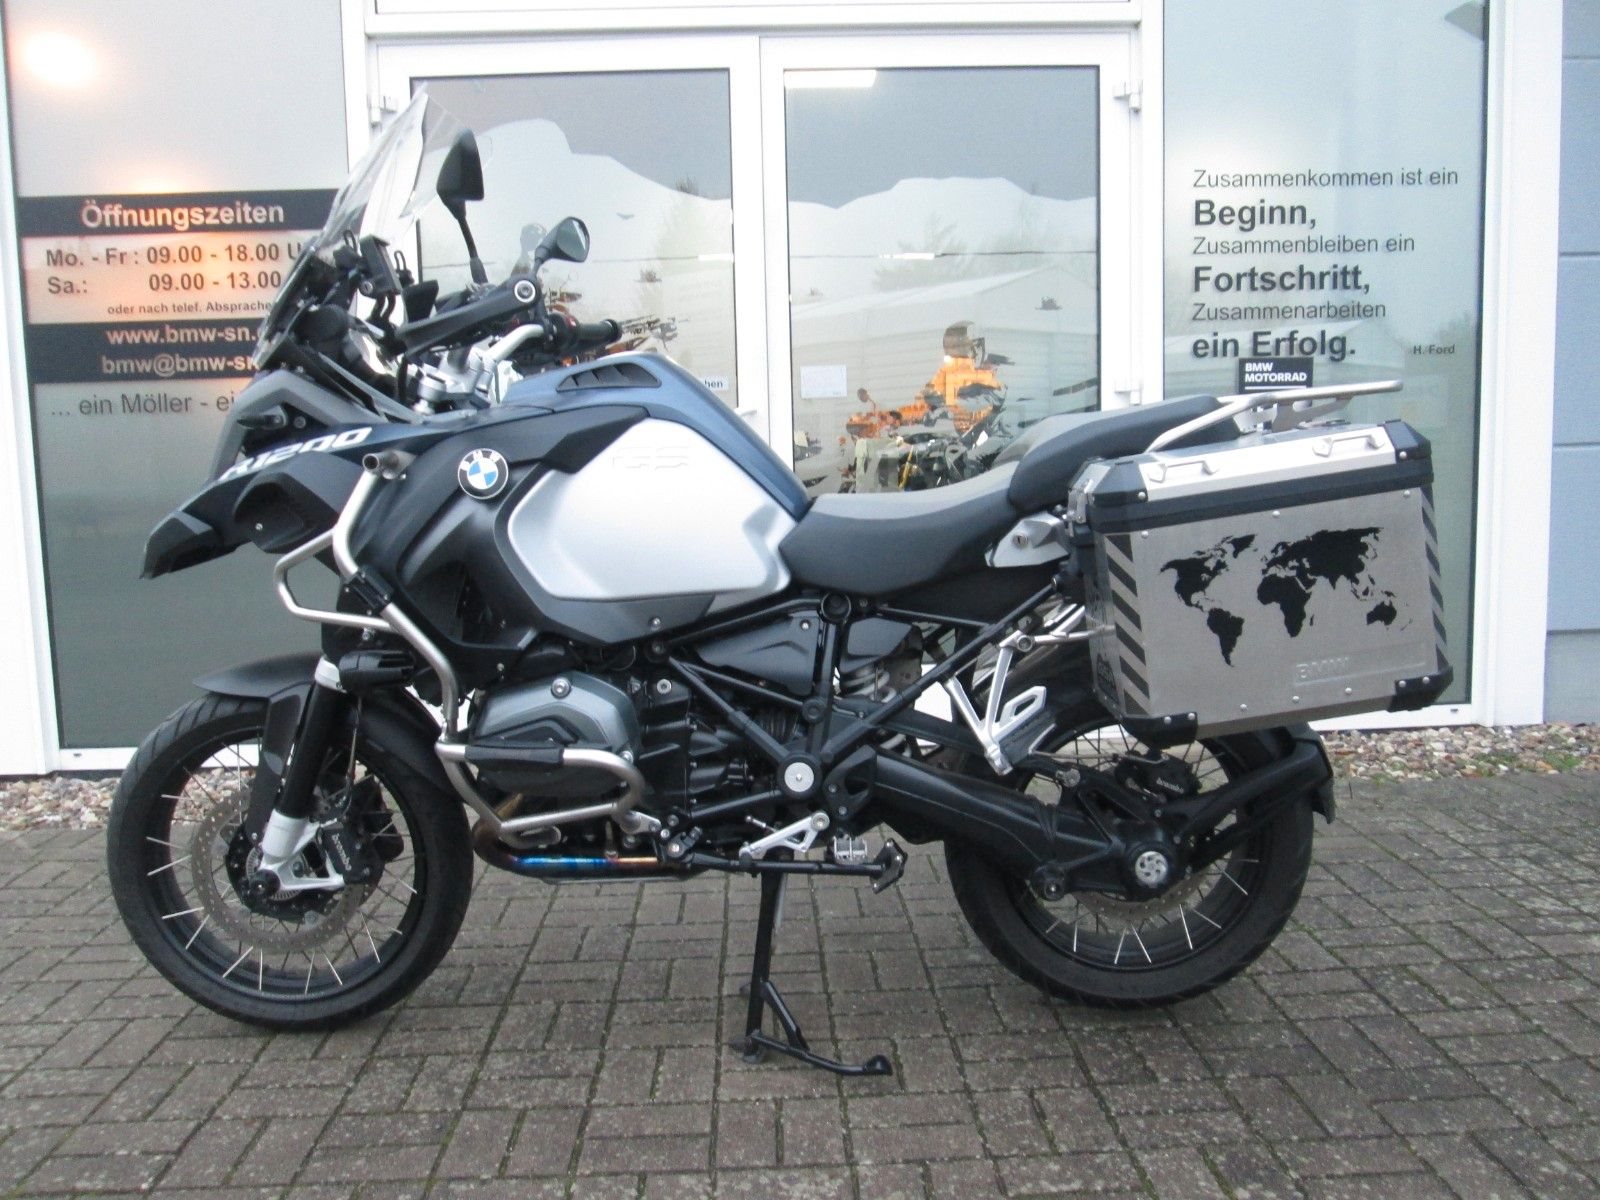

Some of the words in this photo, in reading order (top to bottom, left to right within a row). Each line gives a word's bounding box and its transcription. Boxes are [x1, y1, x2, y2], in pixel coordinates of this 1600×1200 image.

[1192, 168, 1393, 188] Zusammenkommen
[1400, 168, 1423, 186] ist
[1429, 167, 1459, 186] ein
[81, 199, 285, 232] Öffnungszeiten
[1194, 199, 1316, 232] Beginn,
[46, 249, 84, 267] Mo.
[146, 245, 202, 264] 09.00
[224, 243, 280, 262] 18.00
[1192, 235, 1379, 256] Zusammenbleiben
[1385, 234, 1415, 252] ein
[47, 277, 88, 294] Sa.:
[149, 273, 205, 291] 09.00
[226, 271, 282, 290] 13.00
[1194, 264, 1370, 294] Fortschritt,
[107, 305, 135, 315] oder
[138, 303, 168, 314] nach
[171, 302, 202, 313] telef.
[1191, 301, 1387, 322] Zusammenarbeiten
[105, 325, 262, 344] www.bmw-sn.
[1192, 331, 1240, 359] ein
[1252, 329, 1356, 362] Erfolg.
[1428, 343, 1456, 355] Ford
[1244, 362, 1274, 372] BMW
[1244, 372, 1308, 383] MOTORRAD
[79, 393, 113, 414] ein
[122, 392, 193, 414] Möller
[1295, 655, 1351, 679] BMW
